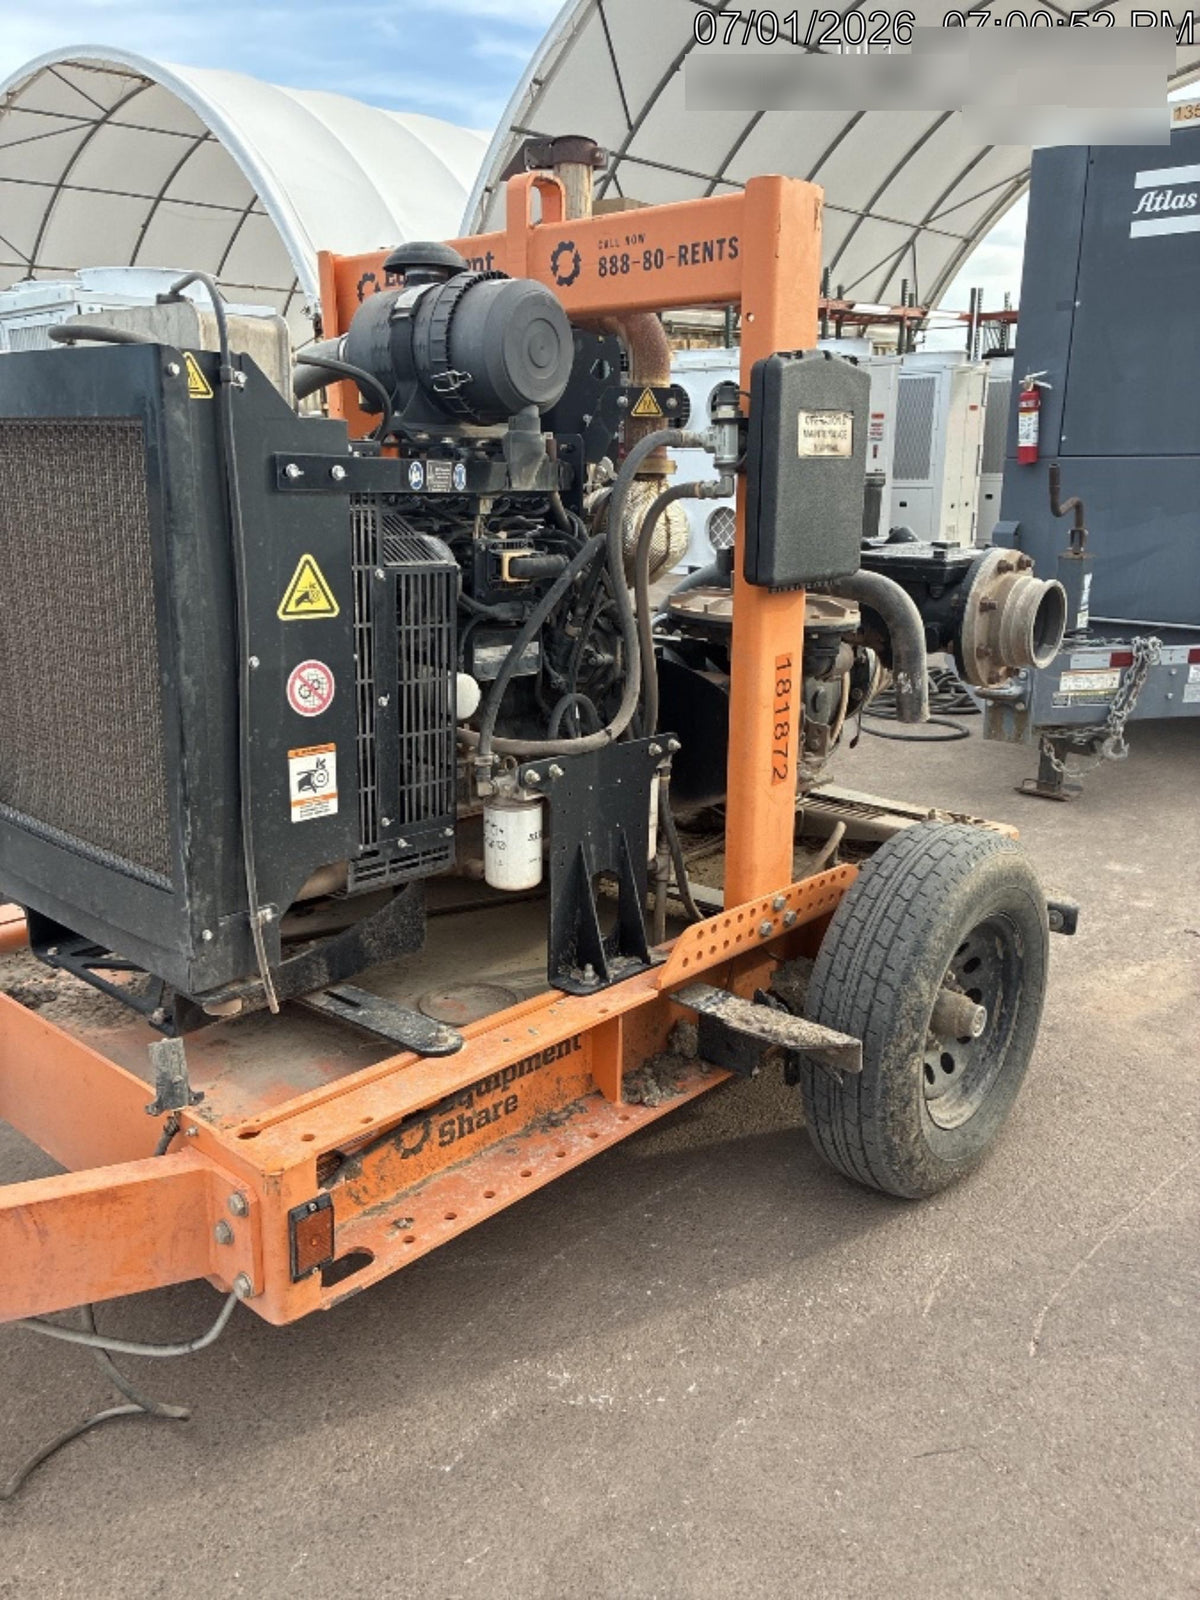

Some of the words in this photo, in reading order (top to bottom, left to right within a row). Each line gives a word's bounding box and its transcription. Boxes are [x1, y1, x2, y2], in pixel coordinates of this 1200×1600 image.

[1132, 190, 1198, 214] Atlas
[598, 235, 739, 278] 888-80-RENTS
[774, 656, 792, 780] 181872
[438, 1093, 518, 1147] Share
